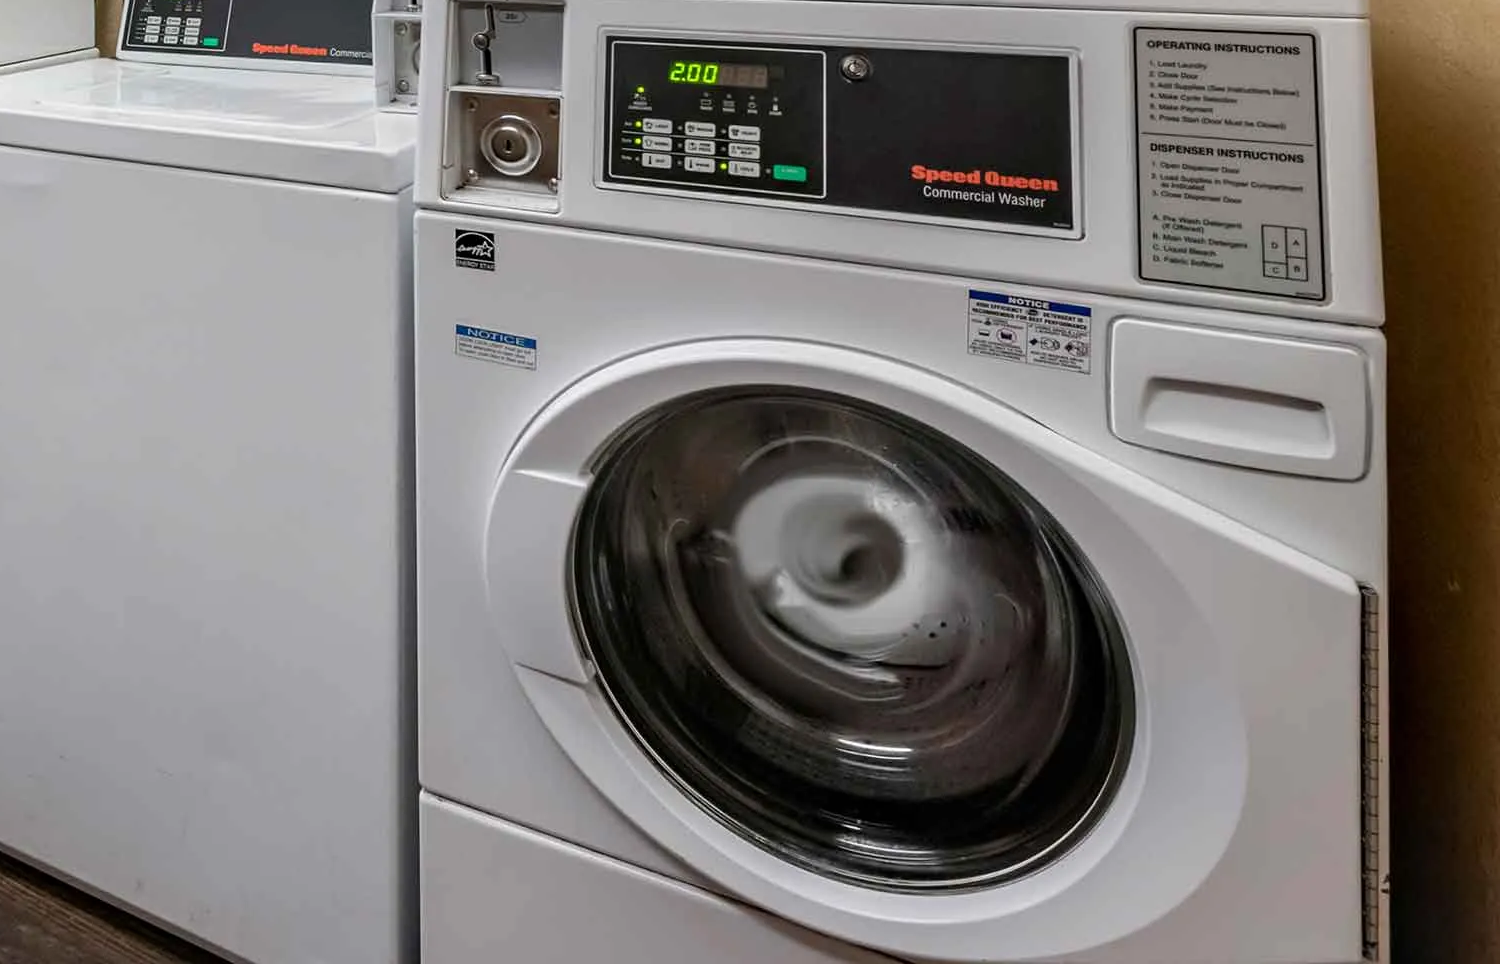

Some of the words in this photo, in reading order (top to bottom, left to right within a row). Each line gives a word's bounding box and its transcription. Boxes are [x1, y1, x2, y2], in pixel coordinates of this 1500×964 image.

[252, 41, 289, 55] Speed
[1146, 40, 1211, 52] OPERATING
[1214, 43, 1301, 55] INSTRUCTIONS
[669, 62, 720, 84] 2.00
[1150, 142, 1215, 157] DISPENSER
[1217, 148, 1305, 164] INSTRUCTIONS
[911, 164, 982, 184] Speed
[985, 170, 1059, 192] Queen
[923, 185, 995, 204] Commercial
[998, 192, 1047, 208] Washer
[1007, 296, 1051, 310] NOTICE
[467, 327, 526, 347] NOTICE
